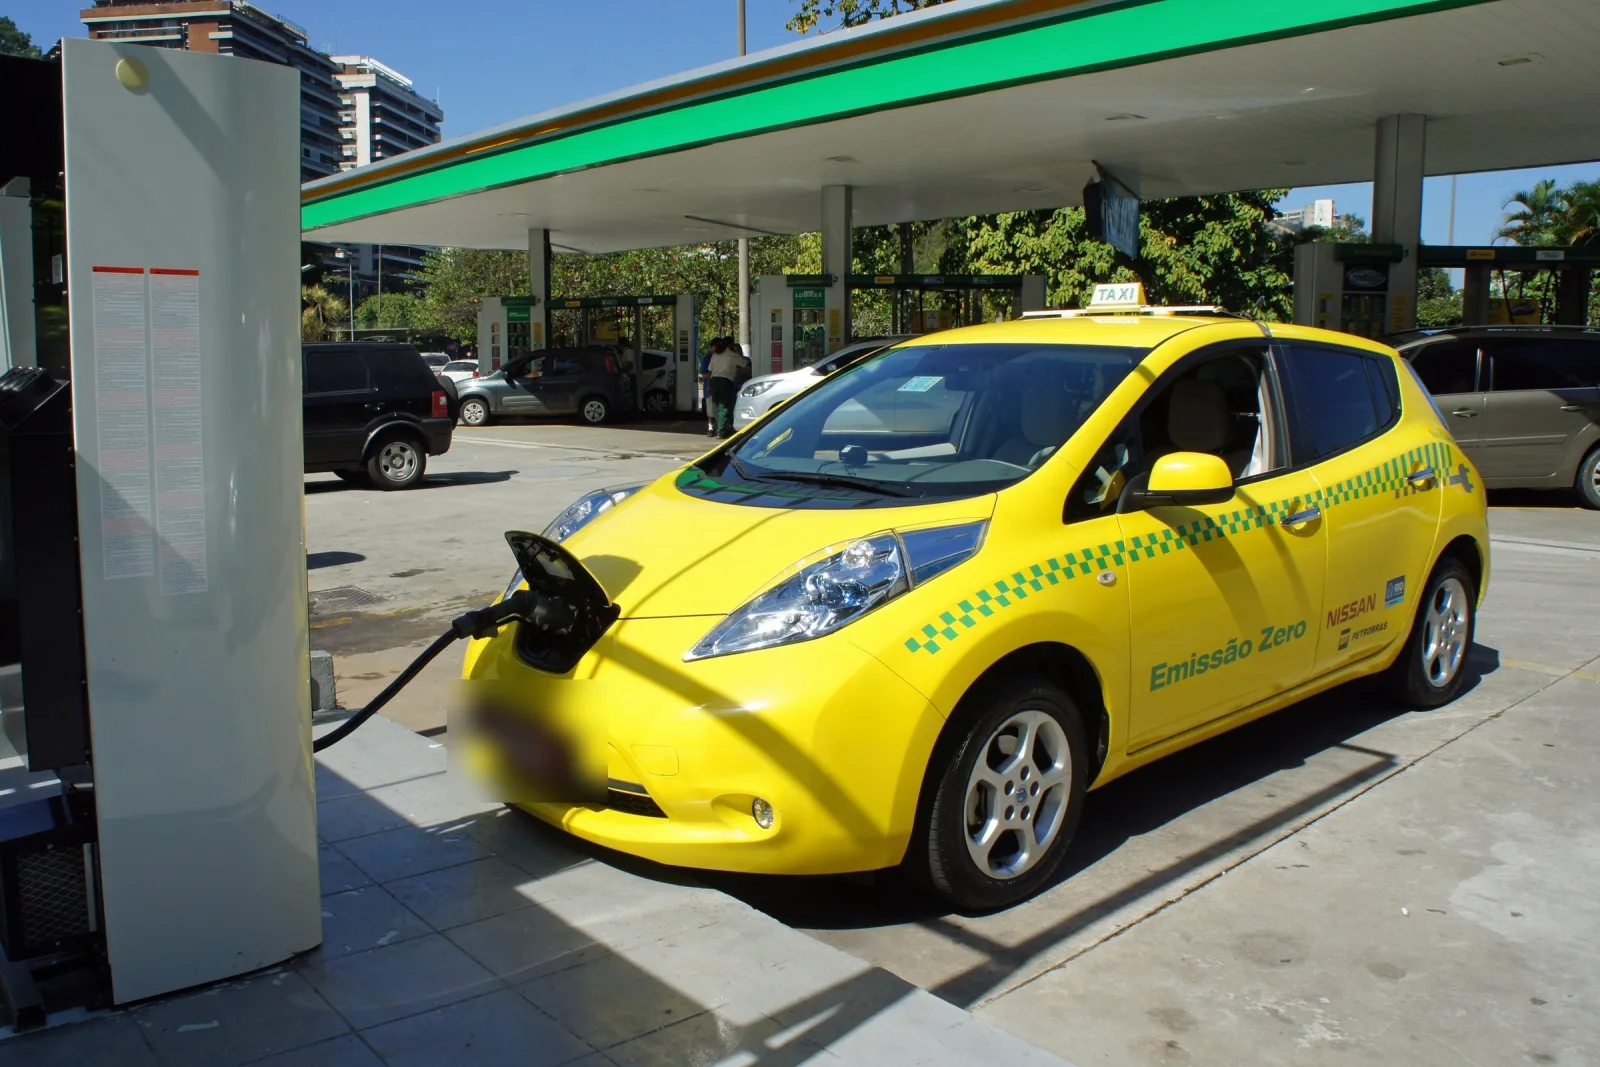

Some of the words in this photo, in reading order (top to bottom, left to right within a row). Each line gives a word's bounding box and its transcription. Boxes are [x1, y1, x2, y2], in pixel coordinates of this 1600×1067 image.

[1098, 287, 1135, 301] TAXI
[1393, 581, 1404, 593] RIO
[1326, 593, 1376, 629] NISSAN
[1351, 621, 1388, 641] PETROBRAS
[1149, 637, 1253, 692] Emissão
[1258, 620, 1307, 653] Zero
